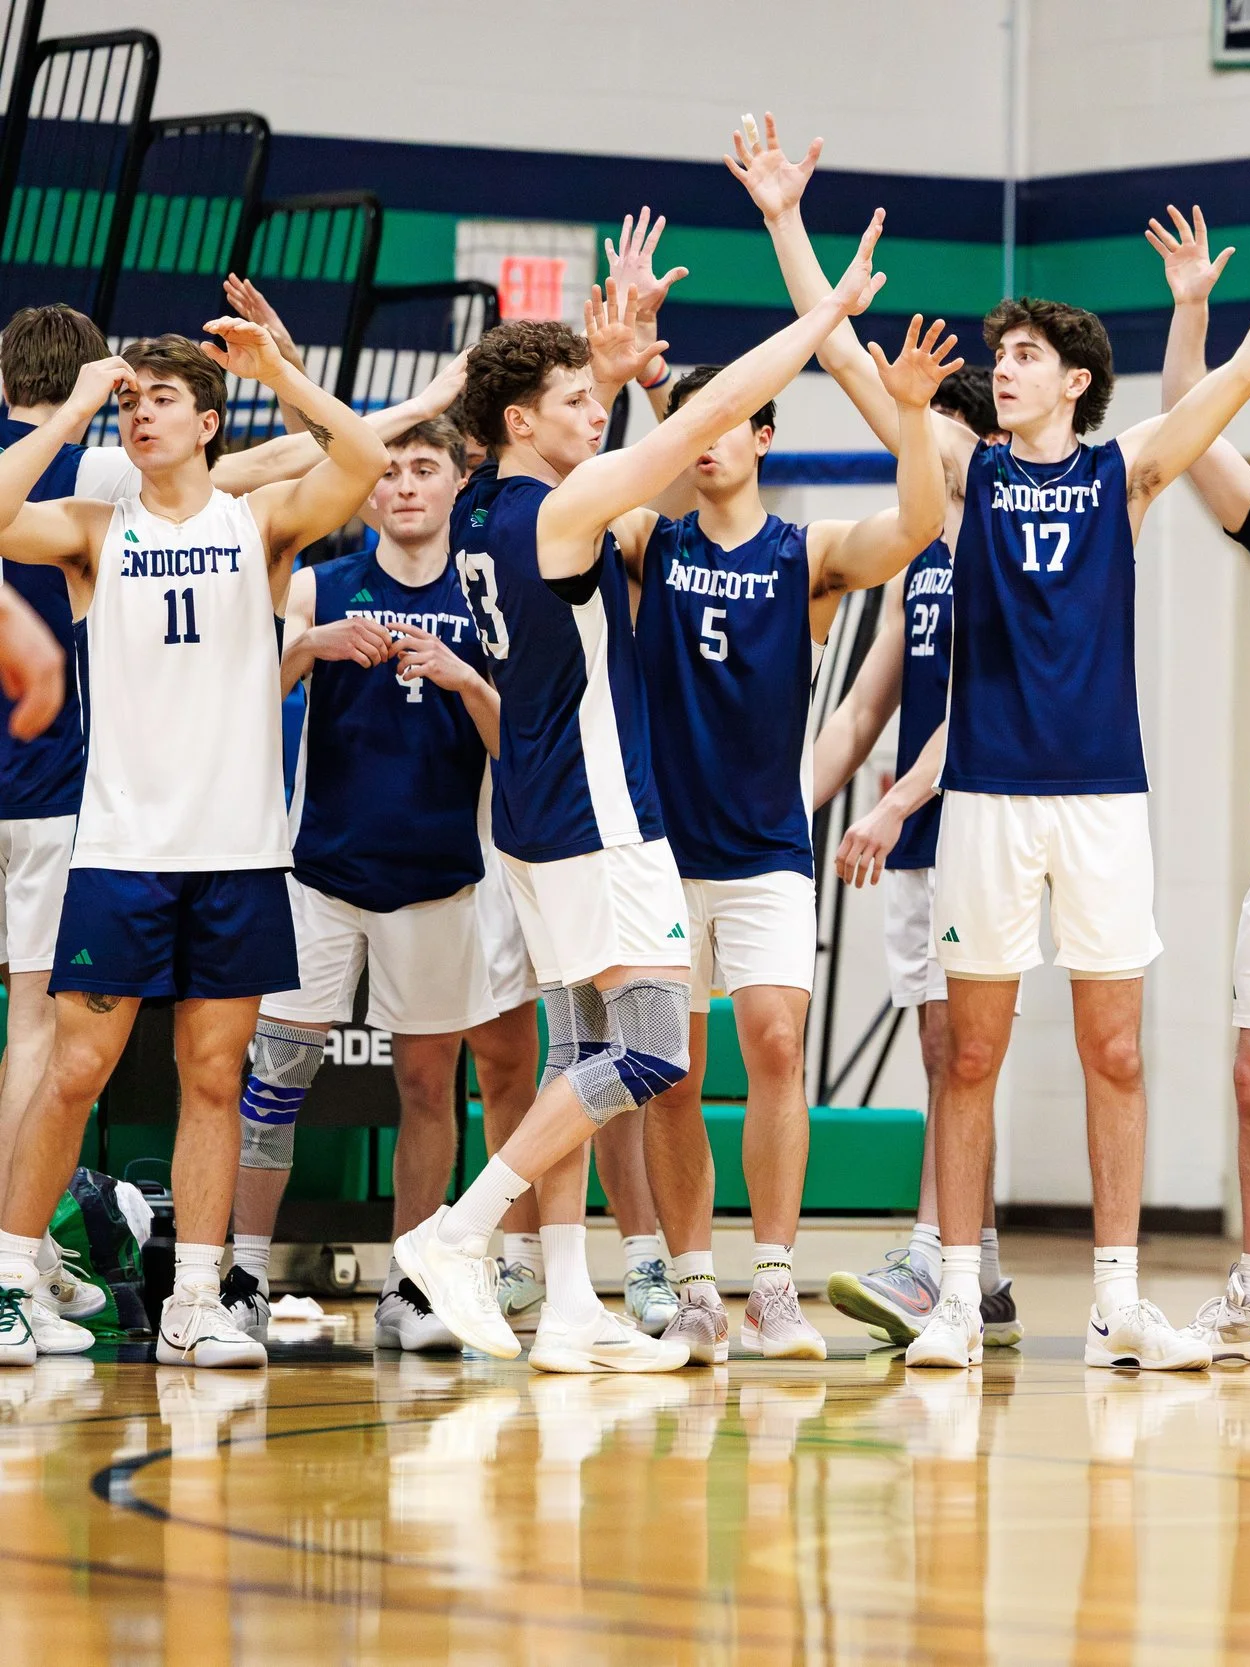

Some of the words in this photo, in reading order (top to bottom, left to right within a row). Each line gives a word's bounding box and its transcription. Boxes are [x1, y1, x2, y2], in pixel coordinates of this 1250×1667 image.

[991, 479, 1102, 513] ENDICOTT
[121, 545, 241, 577] ENDICOTT
[1022, 522, 1071, 572] 17
[164, 587, 200, 644] 11
[700, 606, 728, 662] 5
[911, 603, 940, 656] 22
[395, 651, 424, 703] 4
